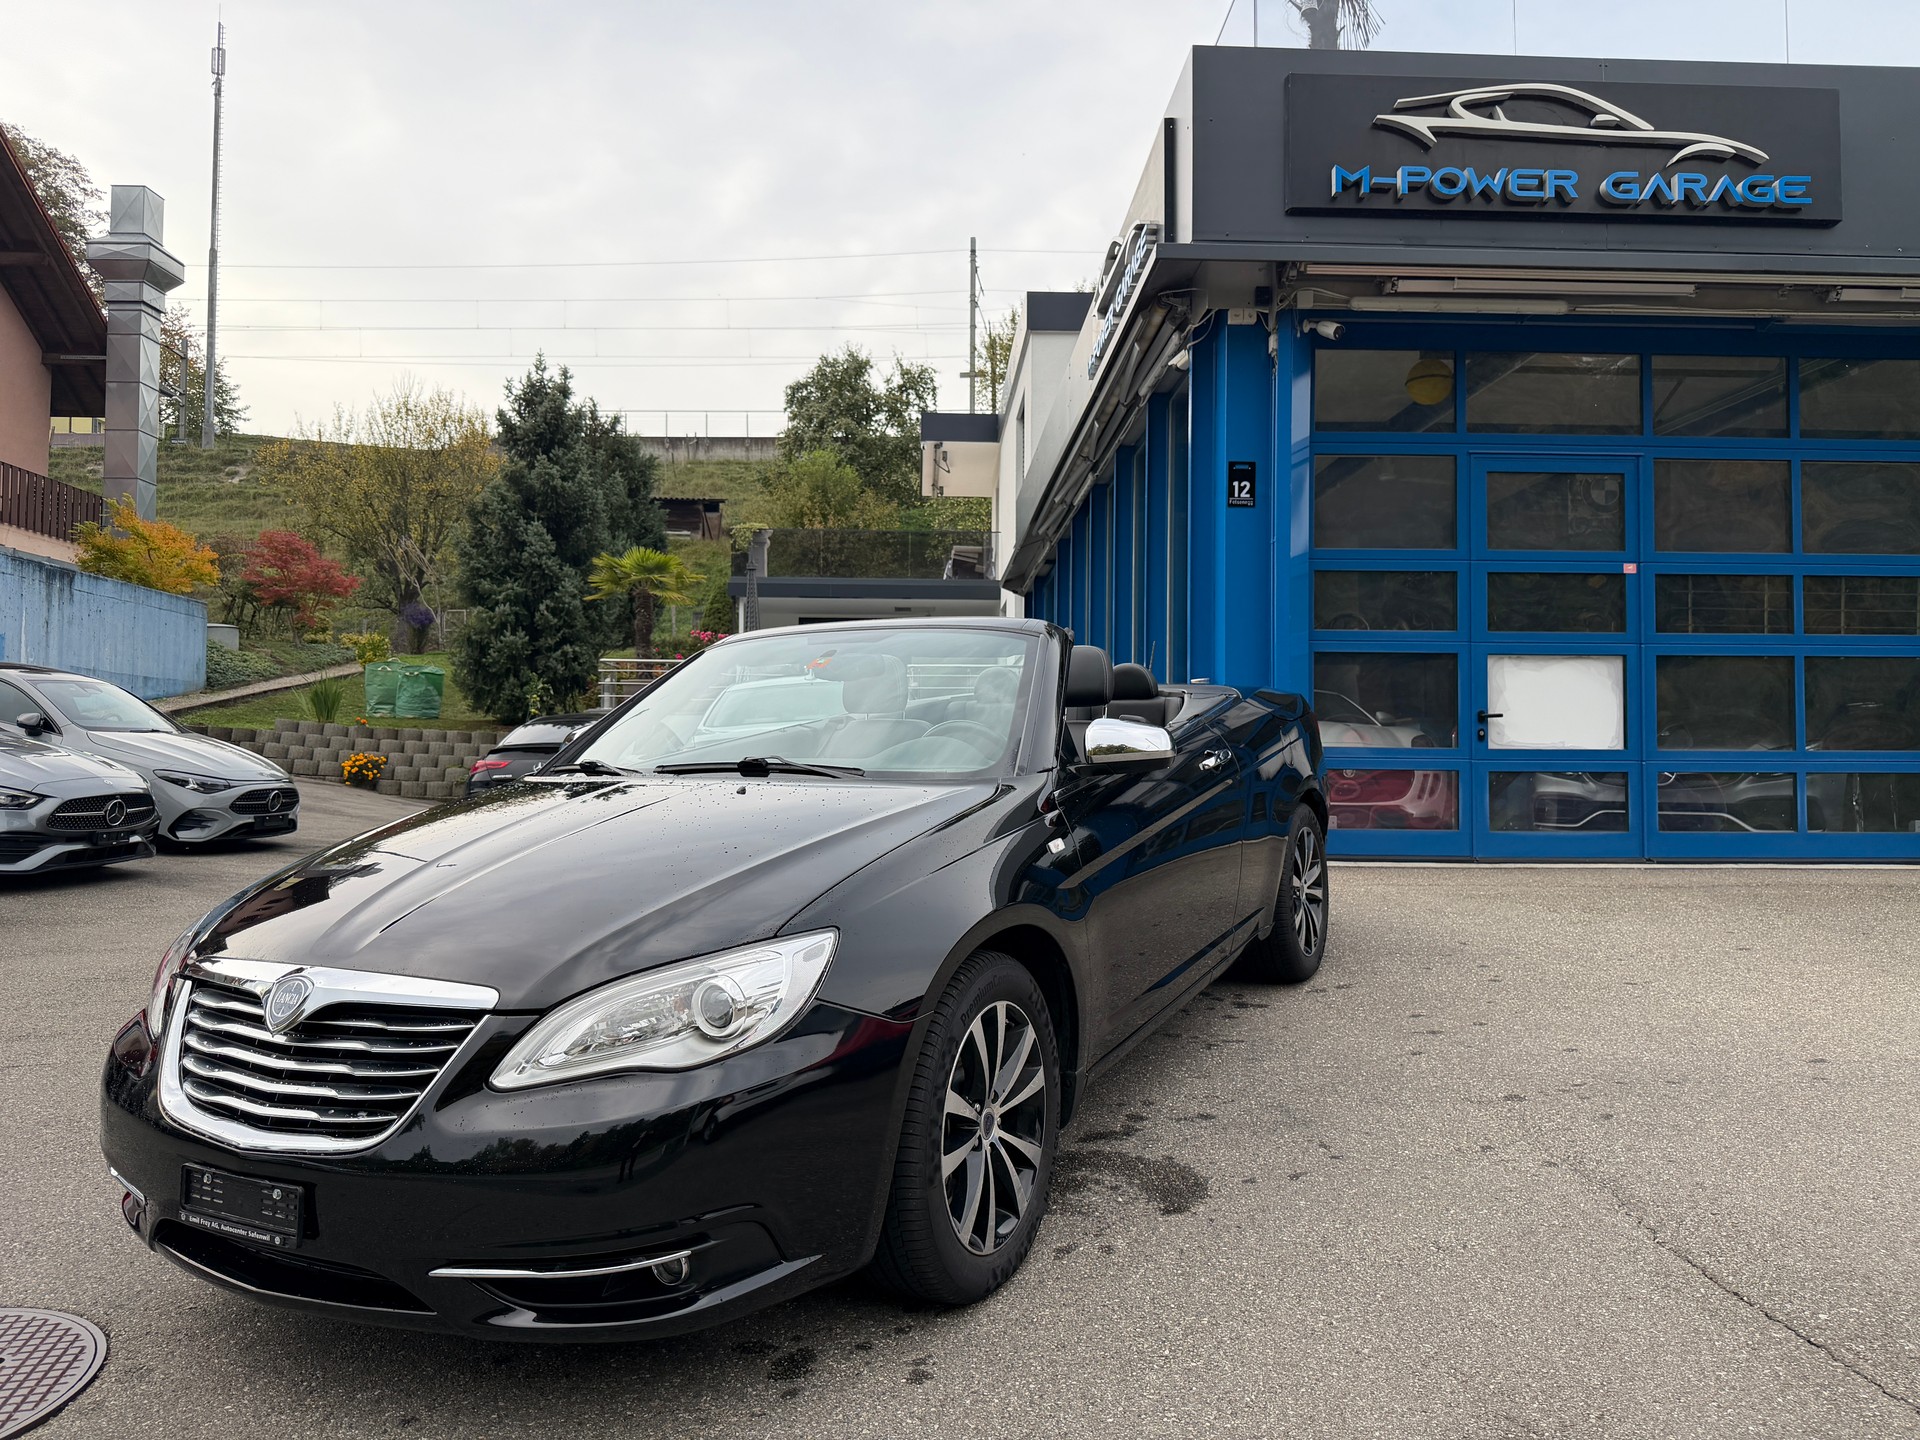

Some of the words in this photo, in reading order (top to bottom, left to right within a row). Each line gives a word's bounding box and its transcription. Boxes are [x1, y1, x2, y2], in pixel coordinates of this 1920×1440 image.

[1331, 164, 1579, 199] M-POWER
[1600, 171, 1812, 204] GARAGE
[1115, 224, 1148, 312] GARAGE
[1232, 481, 1251, 498] 12
[189, 1215, 200, 1224] Emil
[200, 1218, 211, 1228] Frey
[220, 1224, 248, 1236] Autocenter
[248, 1230, 271, 1241] Safenwil
